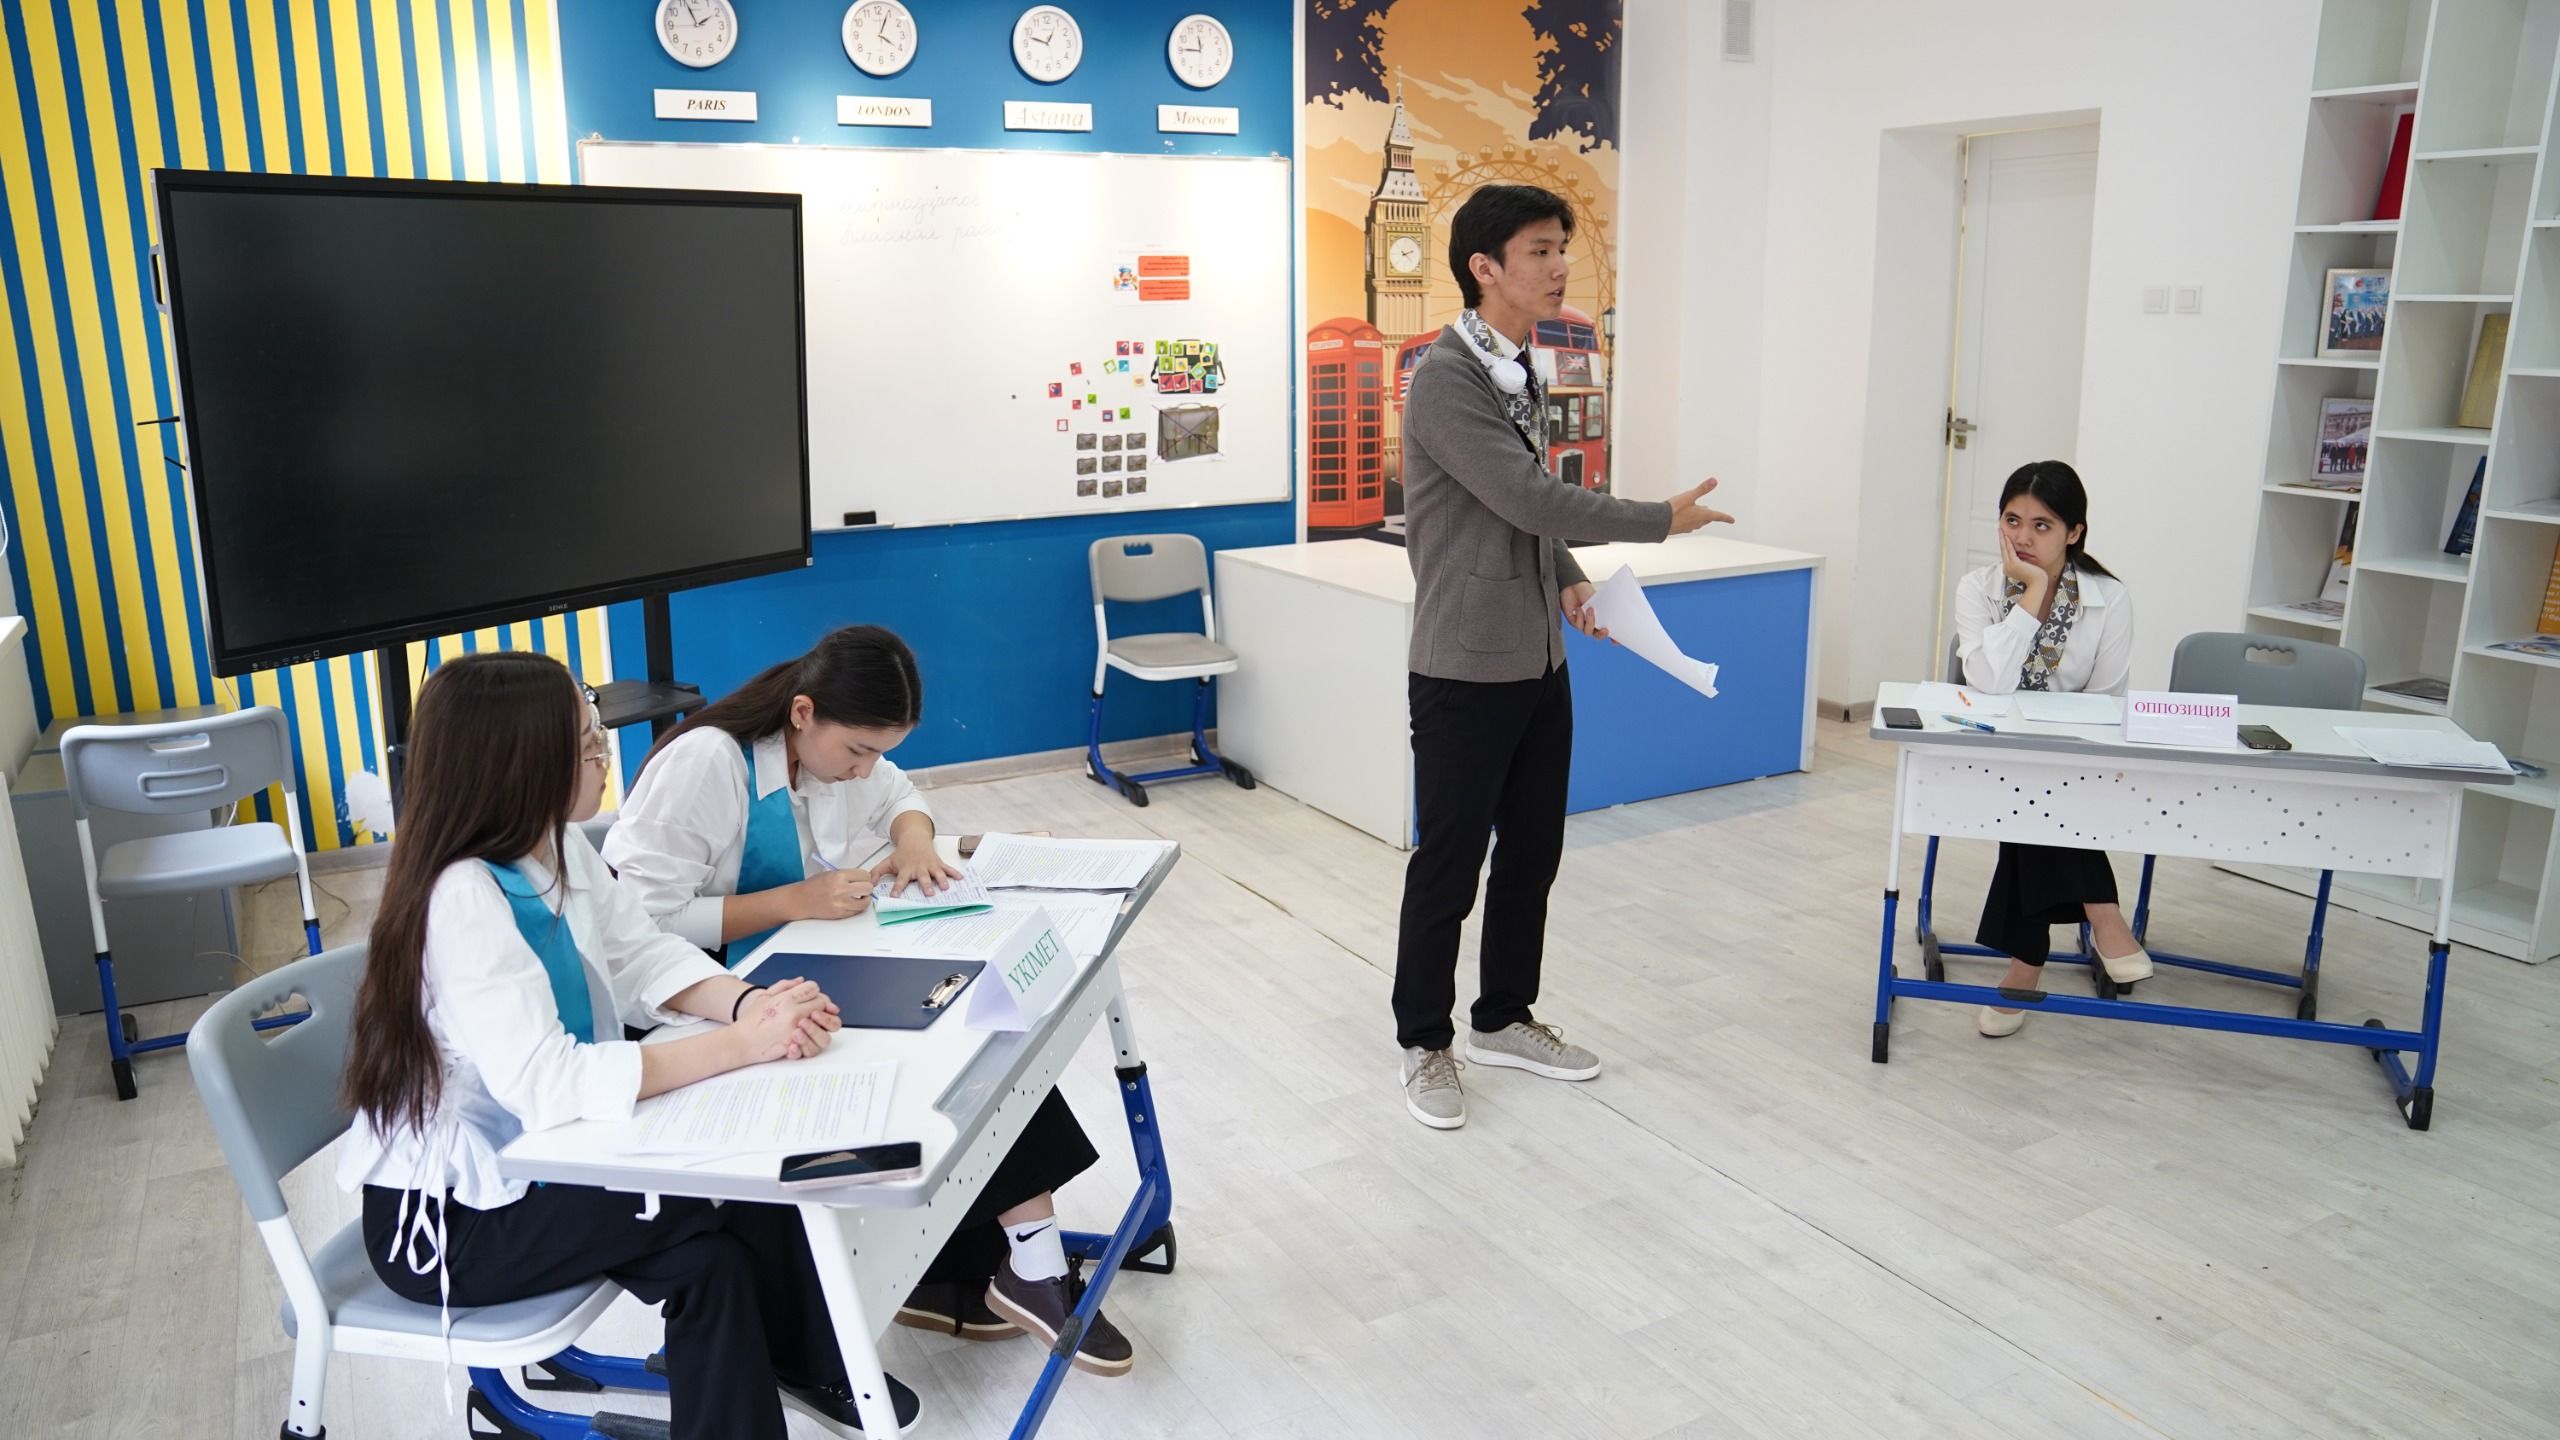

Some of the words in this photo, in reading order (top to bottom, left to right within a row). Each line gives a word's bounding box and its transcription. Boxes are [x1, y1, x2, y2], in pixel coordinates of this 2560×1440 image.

[669, 8, 678, 17] 10
[714, 8, 720, 17] 2
[668, 20, 674, 30] 9
[719, 21, 725, 30] 3
[672, 34, 679, 43] 8
[717, 34, 722, 43] 4
[682, 43, 688, 53] 7
[696, 47, 702, 56] 6
[708, 43, 714, 53] 5
[687, 99, 727, 111] PARIS
[857, 104, 912, 117] LONDON
[1013, 106, 1086, 128] Astana
[1172, 110, 1229, 126] Moscow
[2134, 701, 2231, 718] ОППОЗИЦИЯ
